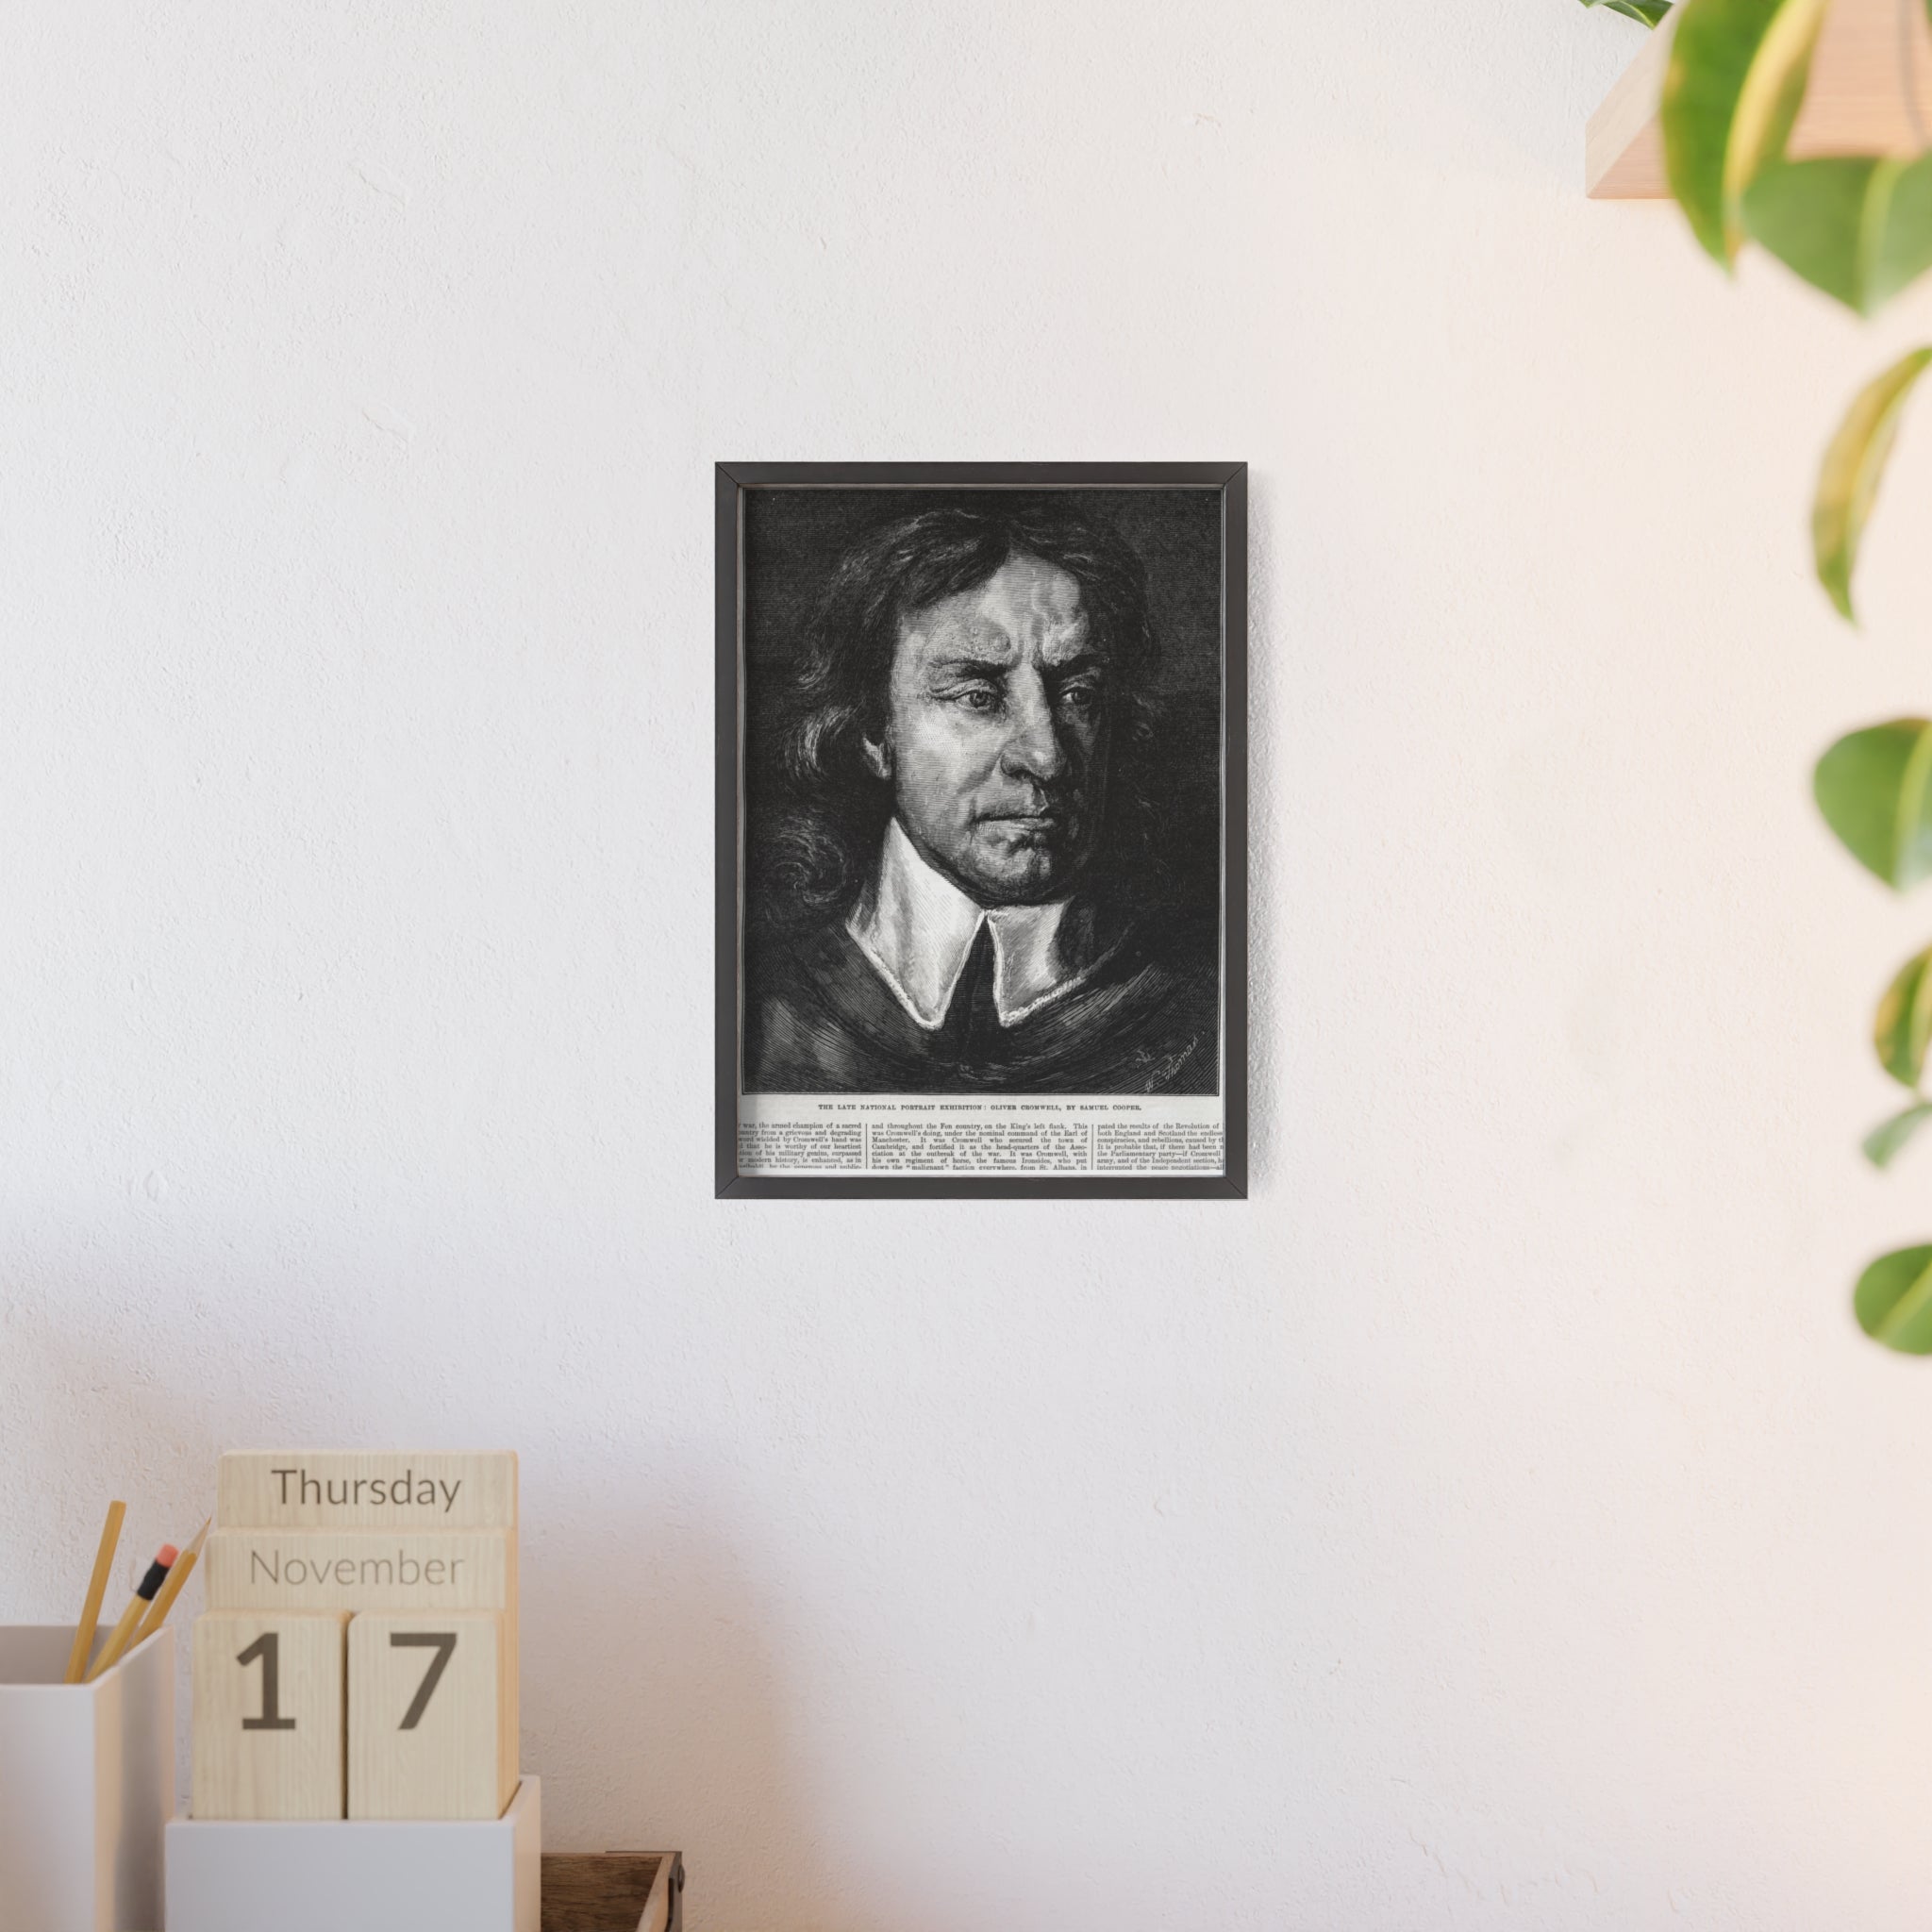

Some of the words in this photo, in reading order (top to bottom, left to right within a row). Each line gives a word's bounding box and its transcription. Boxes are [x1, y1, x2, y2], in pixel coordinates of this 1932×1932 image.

[793, 1122, 823, 1131] champion
[887, 1122, 922, 1131] throughout
[956, 1123, 982, 1131] country,
[1011, 1122, 1030, 1131] King's
[786, 1129, 812, 1138] grievous
[830, 1129, 861, 1138] degrading
[923, 1130, 943, 1138] doing,
[1115, 1130, 1140, 1138] England
[784, 1136, 790, 1144] by
[1208, 1136, 1216, 1145] by
[785, 1142, 807, 1151] worthy
[872, 1143, 908, 1152] Cambridge,
[997, 1143, 1039, 1152] head-quarters
[1115, 1143, 1141, 1152] probable
[1143, 1143, 1158, 1152] that,
[779, 1149, 804, 1158] military
[807, 1150, 829, 1158] genius,
[1037, 1150, 1068, 1159] Cromwell,
[1111, 1150, 1156, 1159] Parliamentary
[776, 1156, 799, 1165] history,
[812, 1156, 842, 1165] enhanced,
[906, 1158, 934, 1166] regiment
[953, 1157, 971, 1166] horse,
[1076, 1158, 1087, 1166] put
[1152, 1157, 1191, 1166] Independent
[1193, 1158, 1216, 1166] section,
[271, 1469, 461, 1512] Thursday
[250, 1549, 465, 1587] November
[390, 1633, 458, 1730] 7
